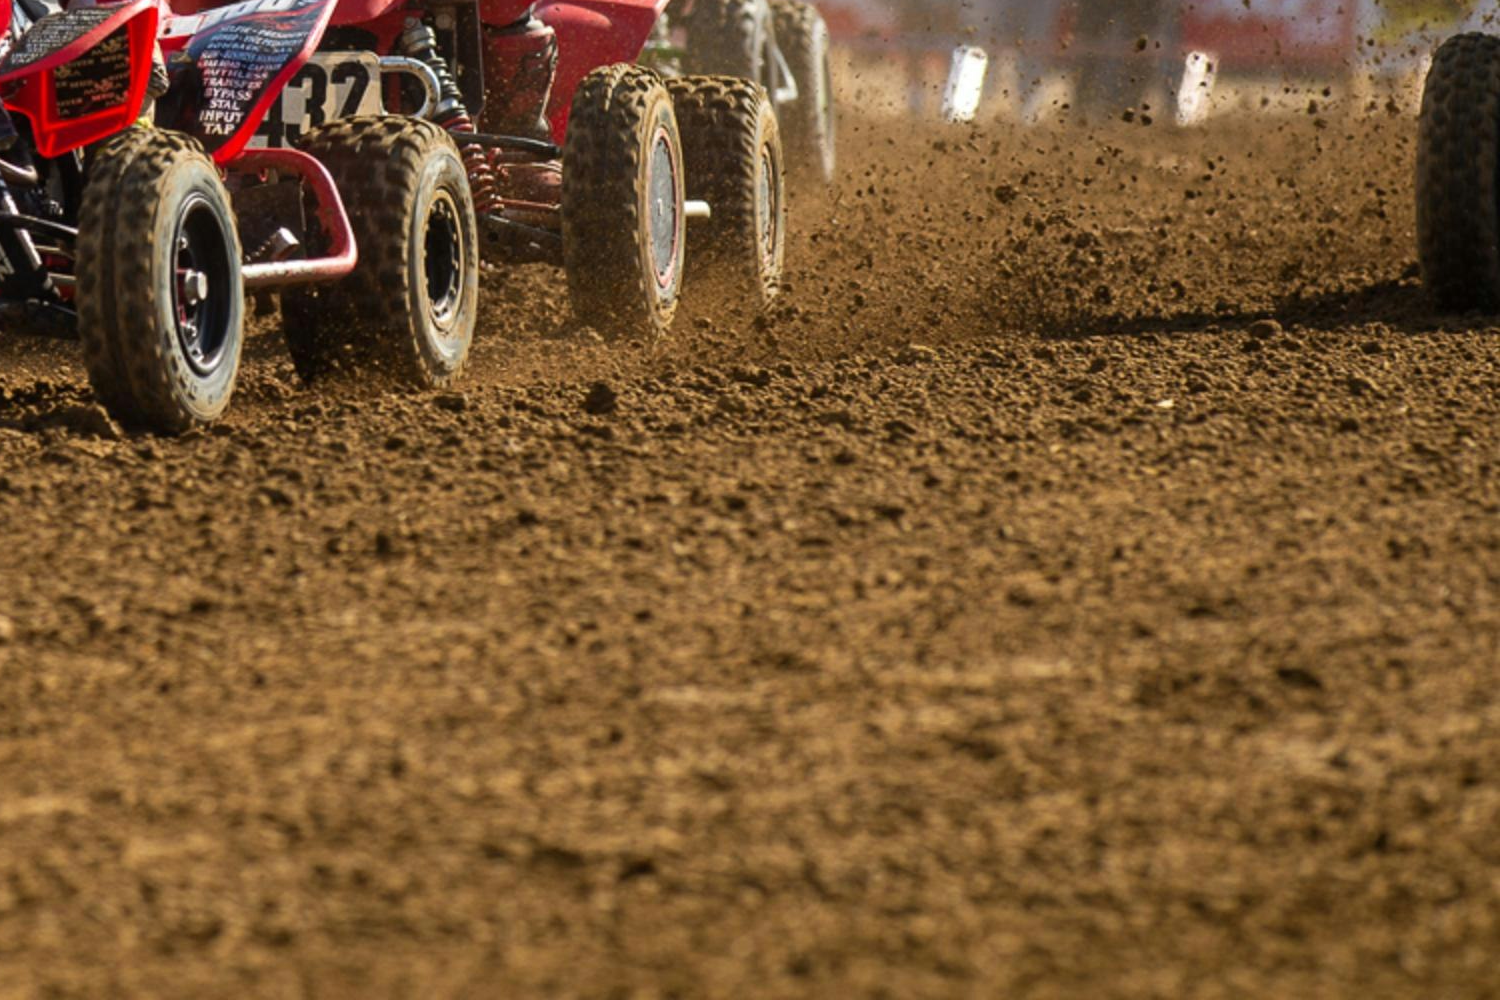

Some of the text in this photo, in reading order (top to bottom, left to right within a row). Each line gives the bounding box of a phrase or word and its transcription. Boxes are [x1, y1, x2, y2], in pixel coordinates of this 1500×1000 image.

[203, 77, 263, 90] TRANSFER
[204, 87, 253, 101] BYPASS
[209, 99, 241, 111] STAL
[199, 109, 244, 123] INPUT
[202, 122, 235, 136] TAP
